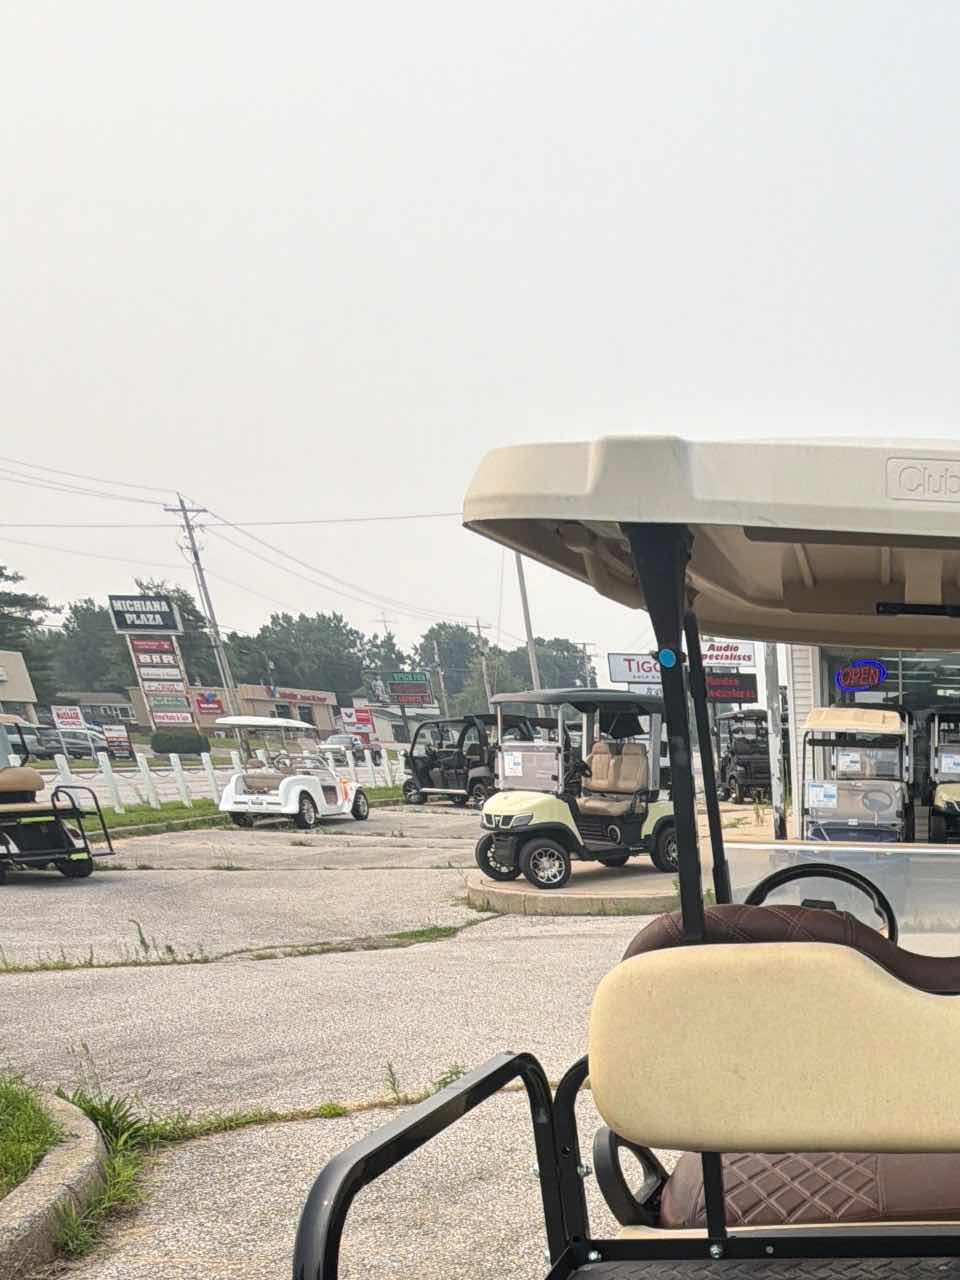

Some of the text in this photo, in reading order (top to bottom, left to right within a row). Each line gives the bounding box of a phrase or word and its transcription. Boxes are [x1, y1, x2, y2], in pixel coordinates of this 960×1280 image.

[112, 600, 170, 612] MICHIANA
[125, 613, 163, 625] PLAZA
[707, 643, 739, 652] Audio
[702, 653, 753, 662] pecialists
[623, 658, 661, 673] TIGO
[839, 666, 880, 687] OPEN
